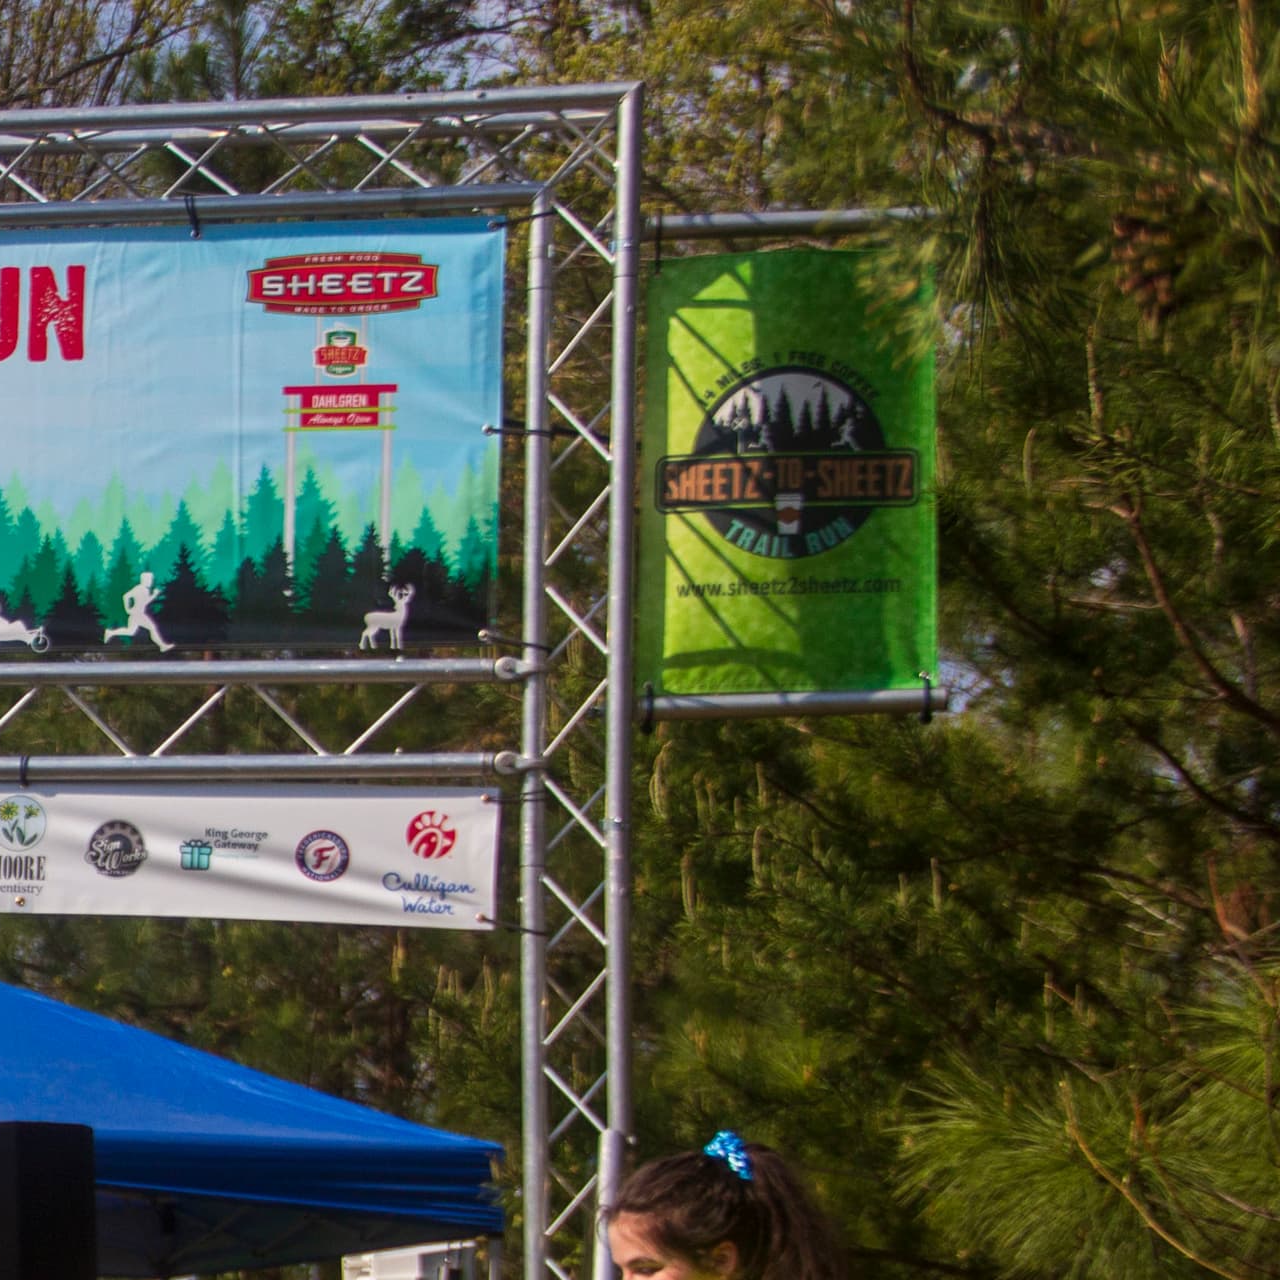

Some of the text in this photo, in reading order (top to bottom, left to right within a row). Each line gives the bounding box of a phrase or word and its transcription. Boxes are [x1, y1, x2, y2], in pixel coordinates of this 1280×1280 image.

[261, 271, 425, 297] SHEETZ
[311, 393, 369, 409] DAHLGREN
[664, 458, 913, 501] SHEETZ-TO-SHEETZ
[724, 517, 855, 558] TRAIL RUN
[676, 577, 901, 598] www.sheetz2sheetz.com
[205, 827, 269, 842] King George
[214, 840, 259, 852] Gateway
[382, 871, 477, 899] Culligan
[400, 894, 456, 915] Water
